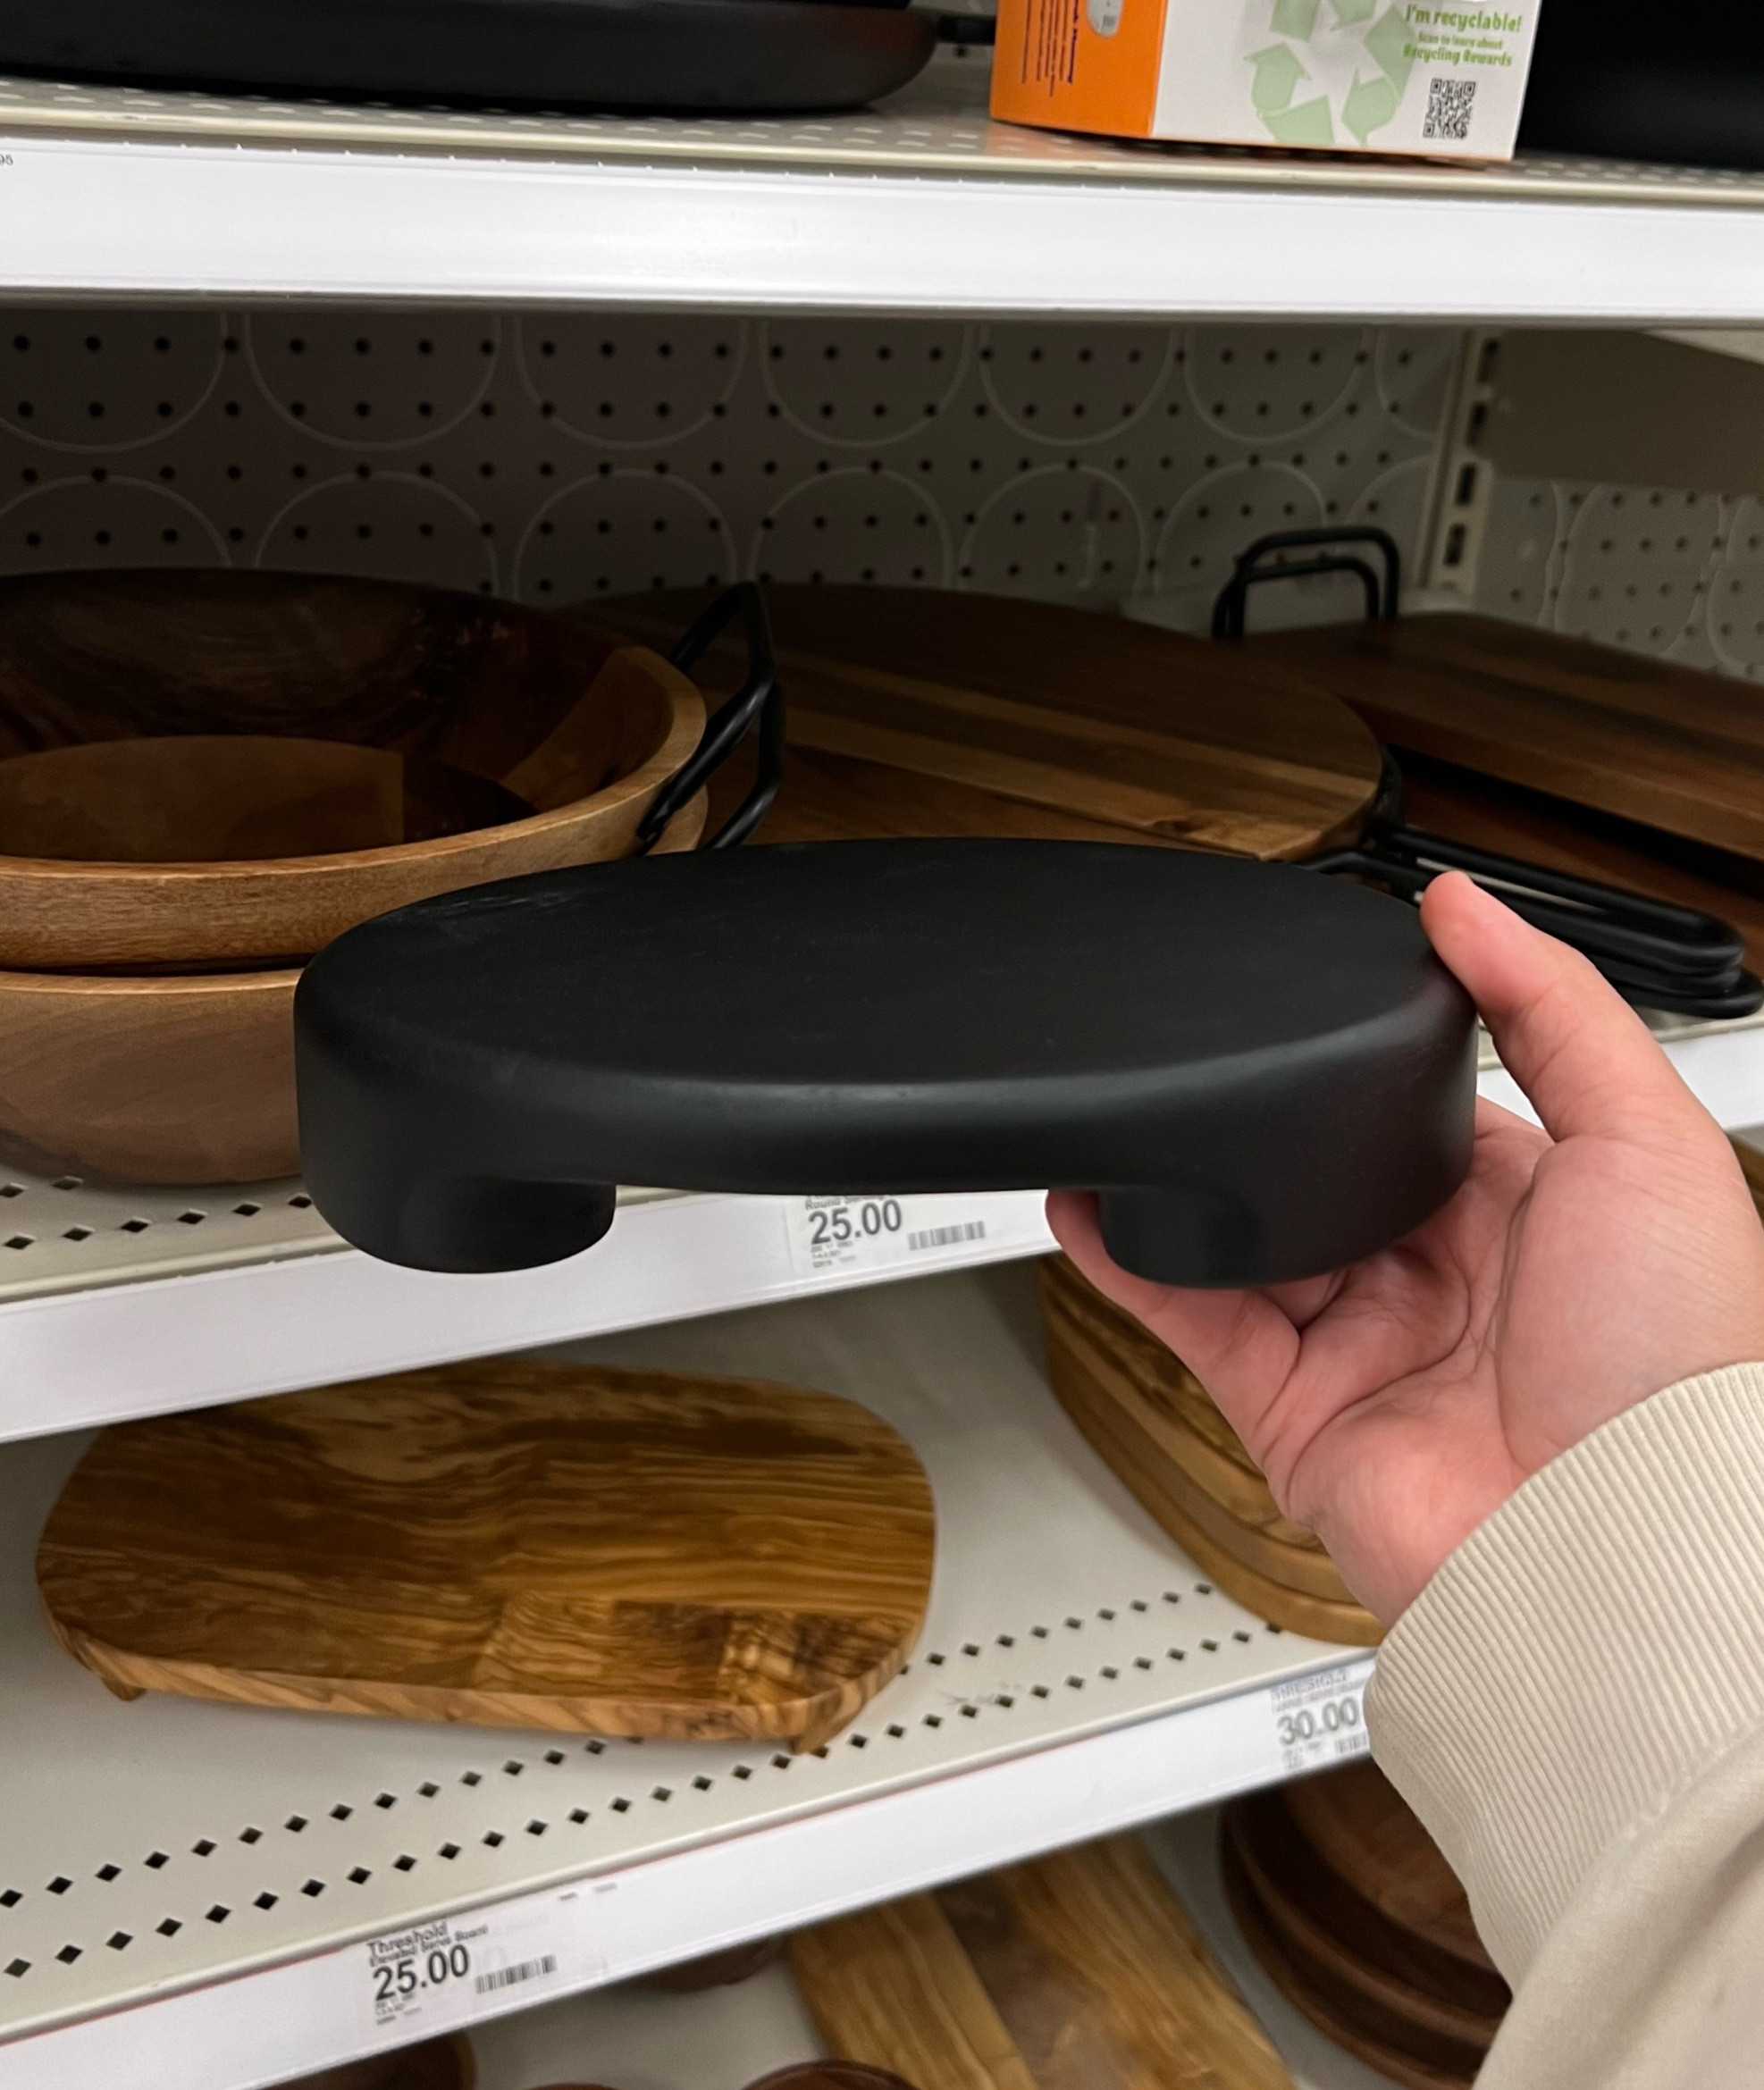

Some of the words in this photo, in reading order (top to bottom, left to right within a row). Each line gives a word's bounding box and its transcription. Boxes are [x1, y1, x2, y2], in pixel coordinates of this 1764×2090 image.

[1406, 4, 1430, 23] I'm
[1433, 10, 1522, 32] recyclable!
[809, 1199, 903, 1245] 25.00
[1277, 1697, 1359, 1745] 30.00
[367, 1921, 447, 1953] Threshold
[374, 1944, 469, 2002] 25.00
